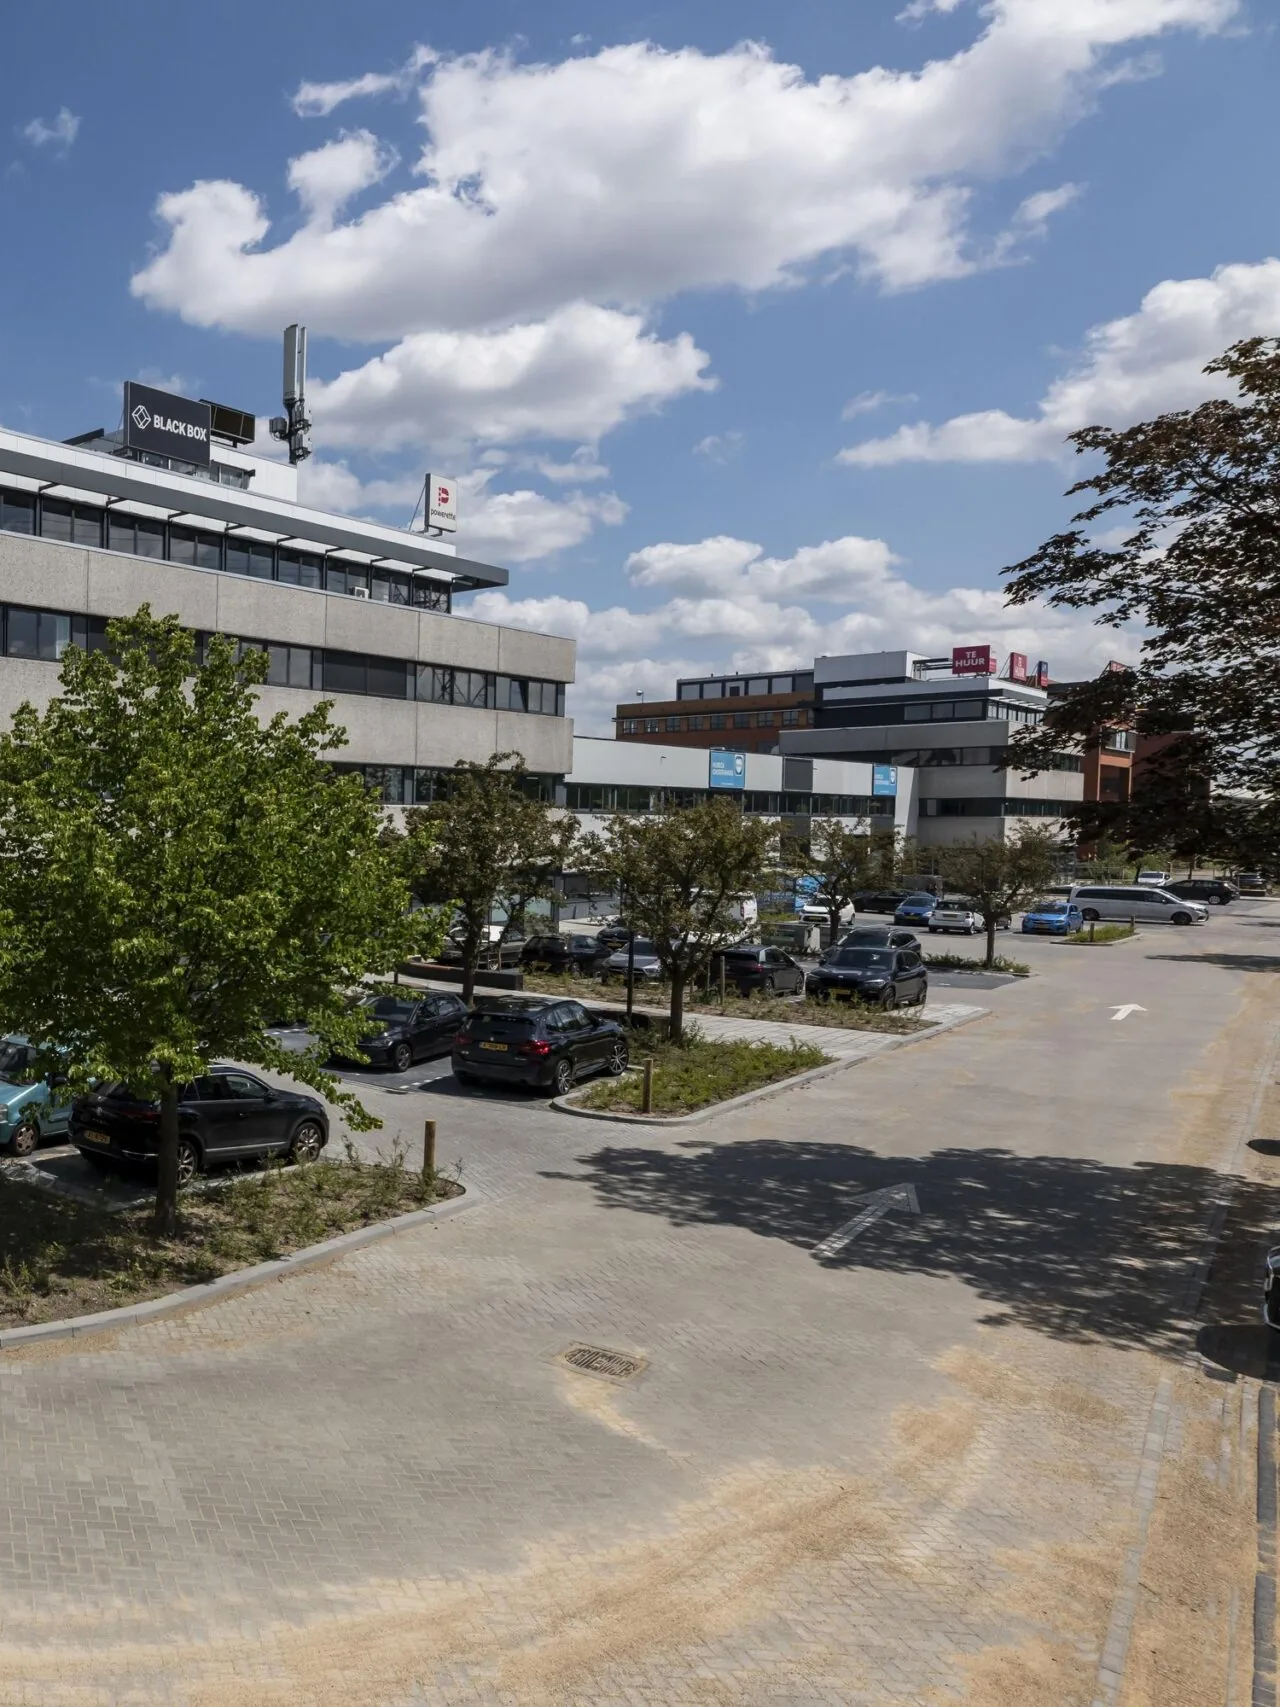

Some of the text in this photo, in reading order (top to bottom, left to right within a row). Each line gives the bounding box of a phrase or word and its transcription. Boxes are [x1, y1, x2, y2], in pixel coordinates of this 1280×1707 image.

[153, 414, 207, 441] BLACK BOX
[965, 650, 977, 659] TE
[955, 657, 985, 668] HUUR
